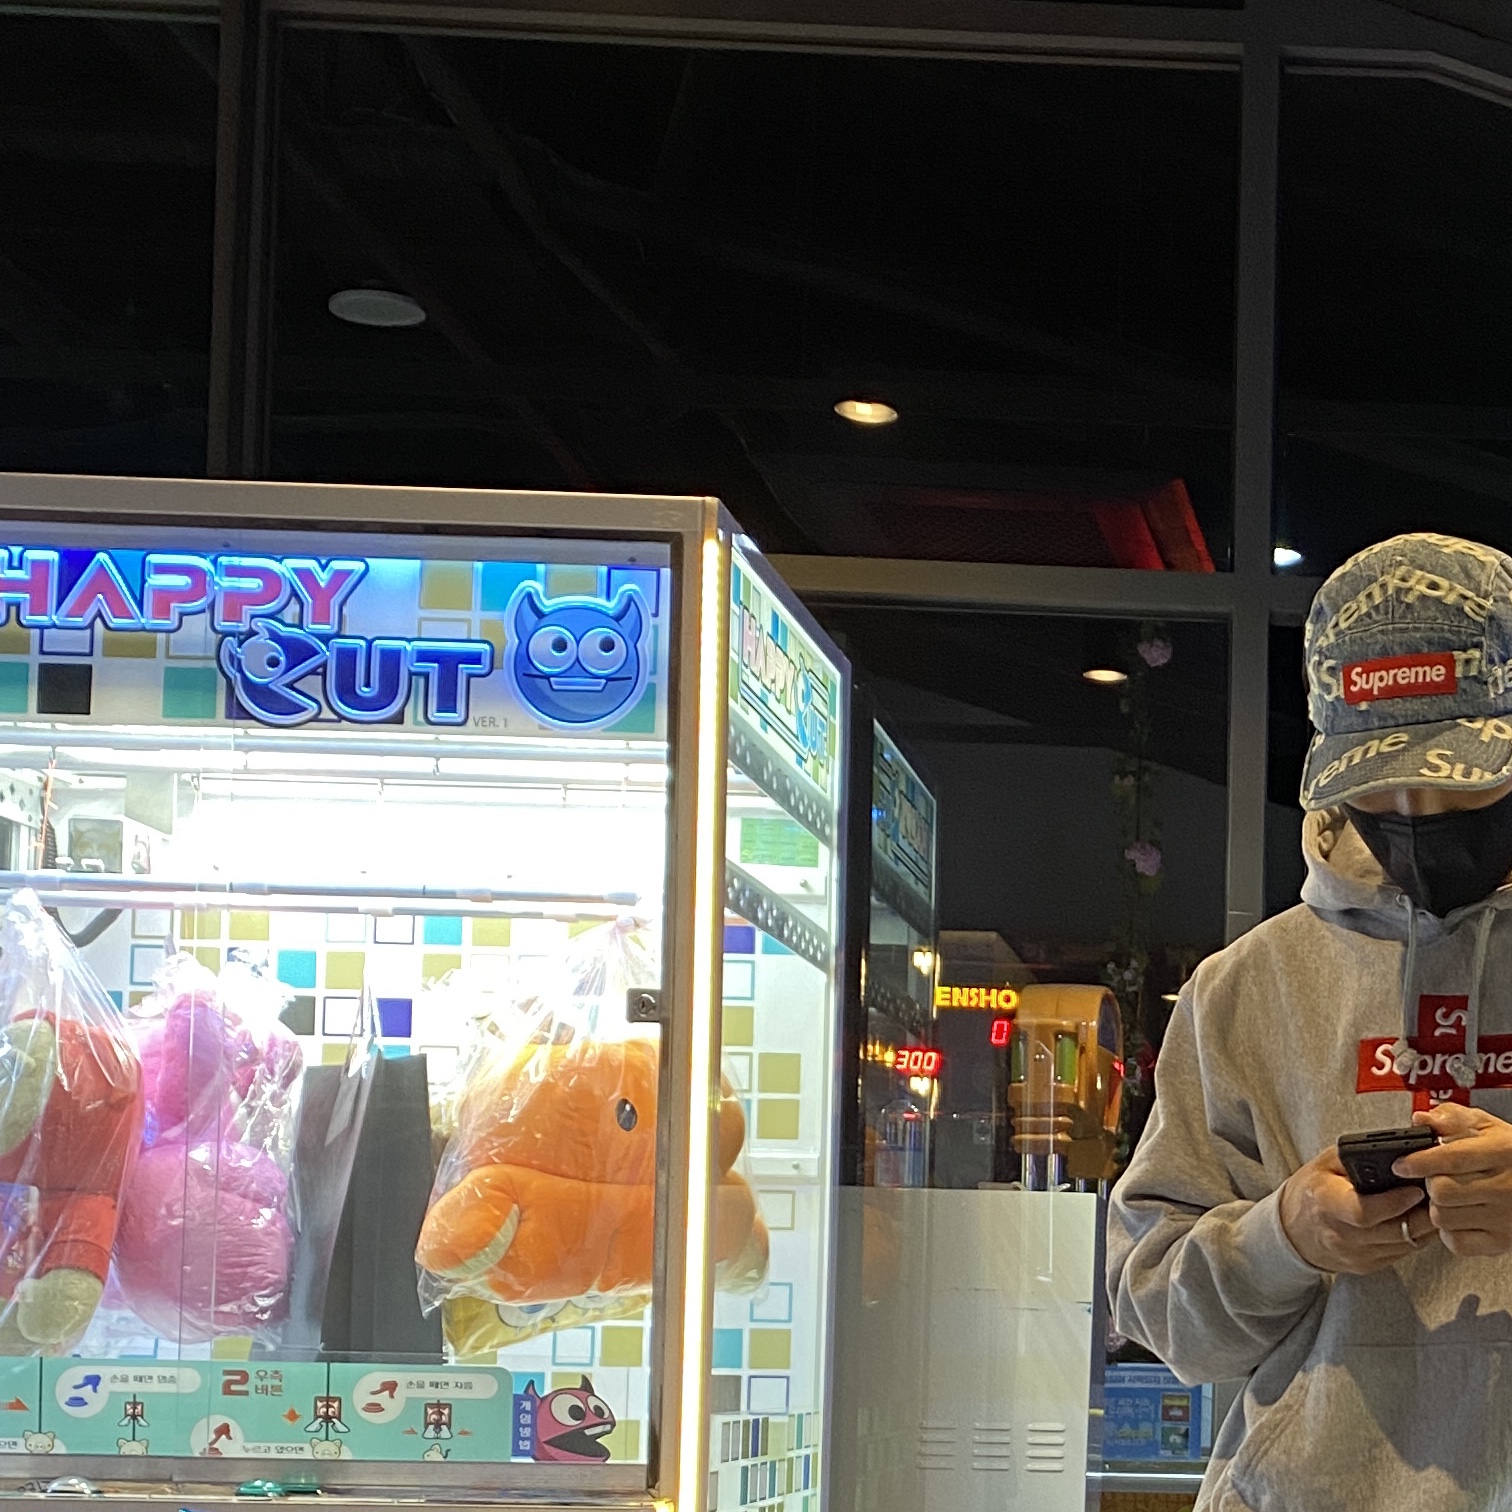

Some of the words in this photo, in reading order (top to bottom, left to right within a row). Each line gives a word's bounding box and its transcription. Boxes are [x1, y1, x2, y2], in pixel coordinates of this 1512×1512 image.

[1349, 664, 1447, 695] Supreme
[472, 716, 500, 728] VER.
[503, 717, 508, 728] 1
[895, 1049, 939, 1071] 300
